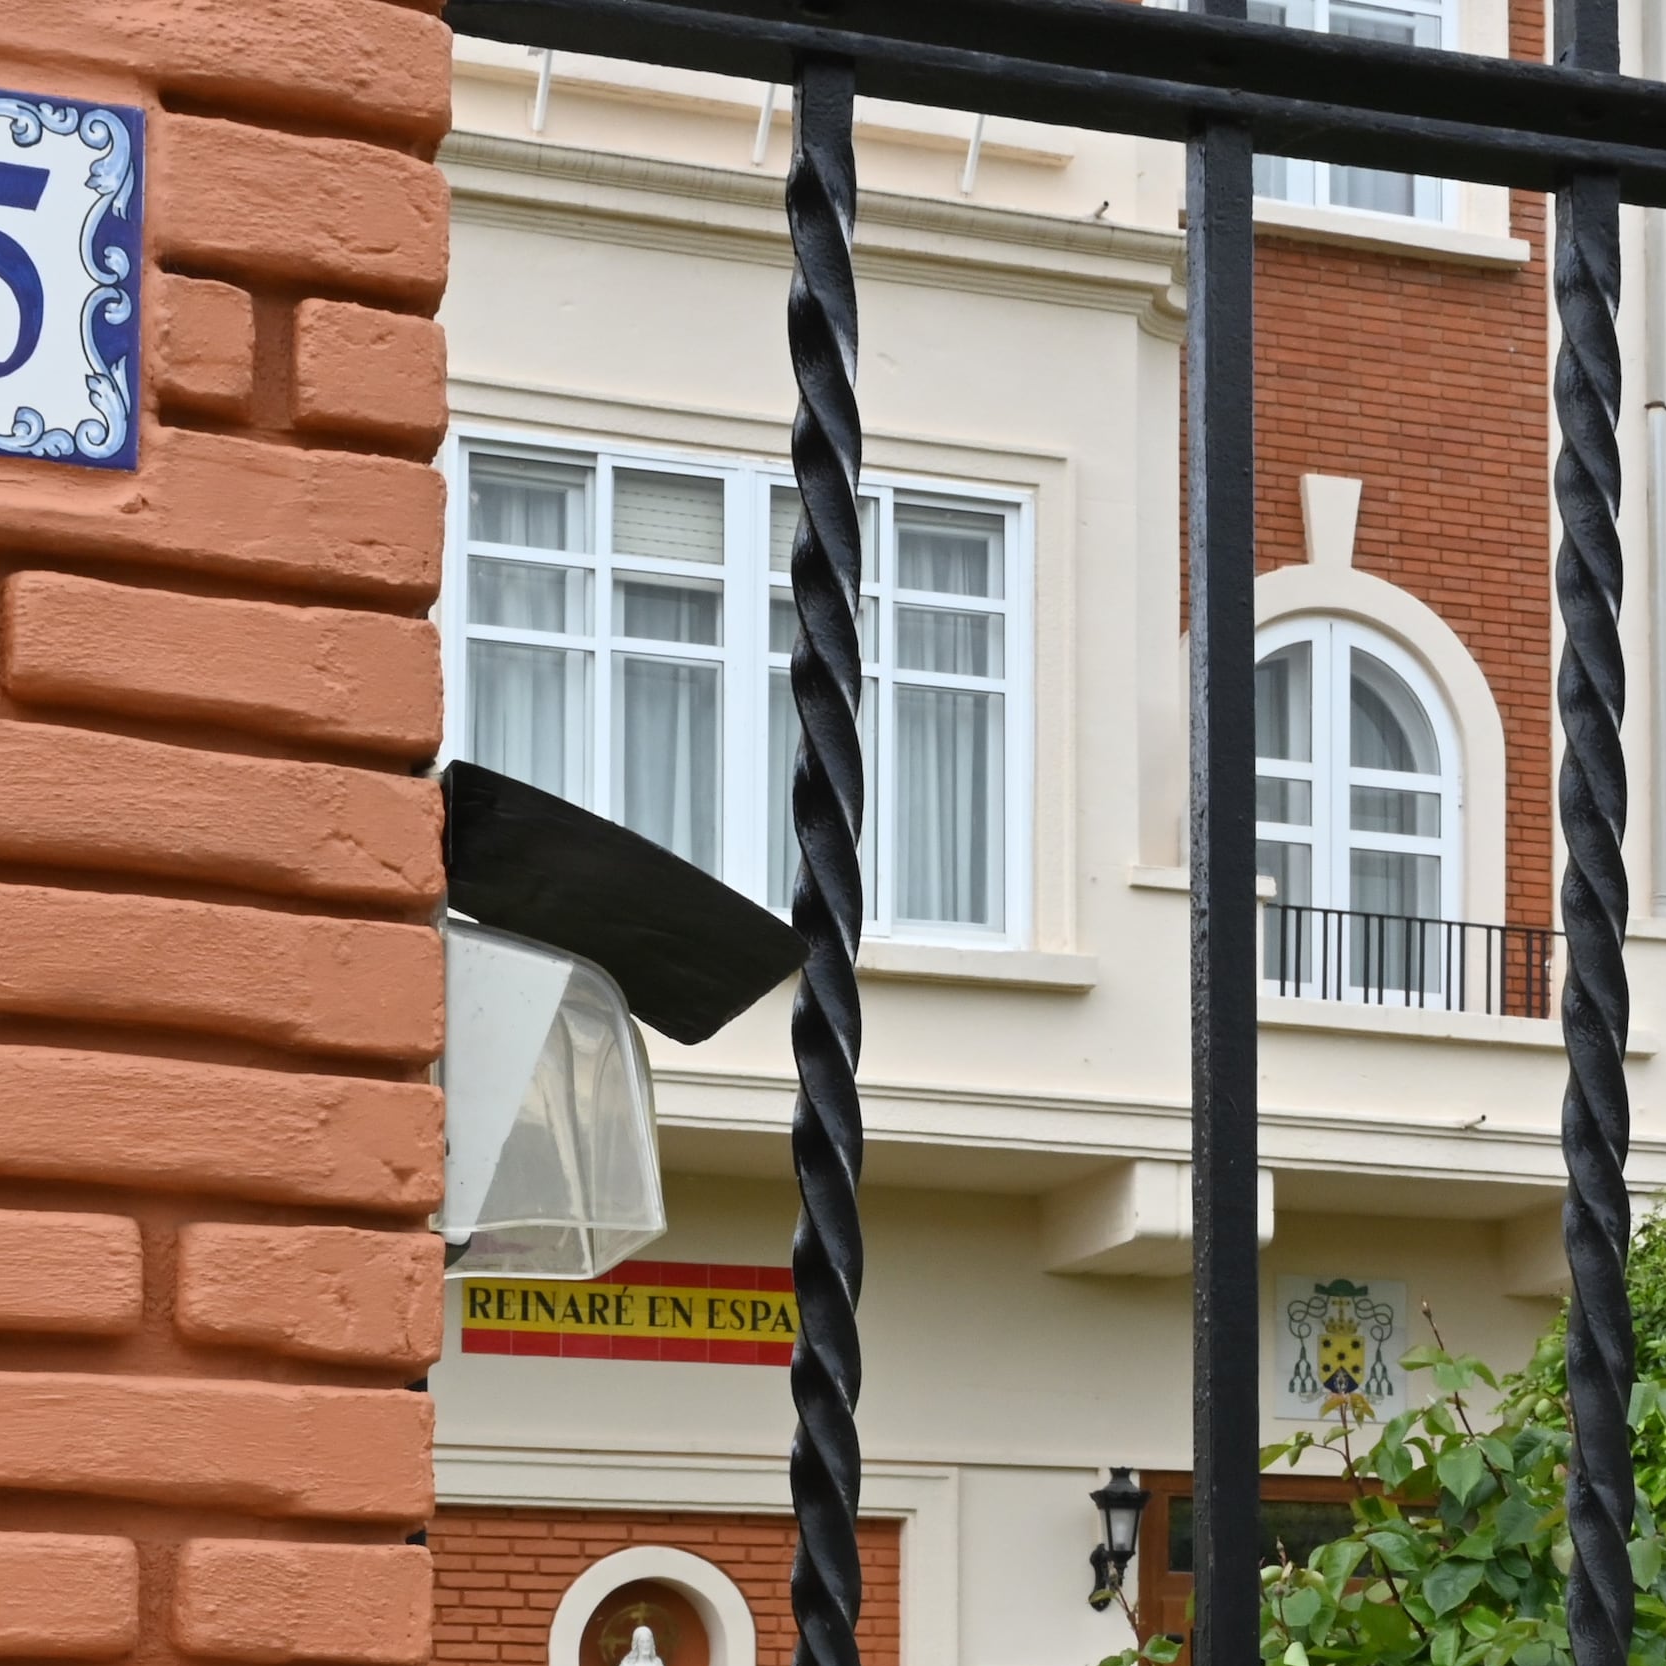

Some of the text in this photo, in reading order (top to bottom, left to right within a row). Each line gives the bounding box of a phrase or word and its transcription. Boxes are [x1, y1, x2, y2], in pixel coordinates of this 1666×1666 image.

[468, 1286, 798, 1334] REINARÉ EN ESPA
